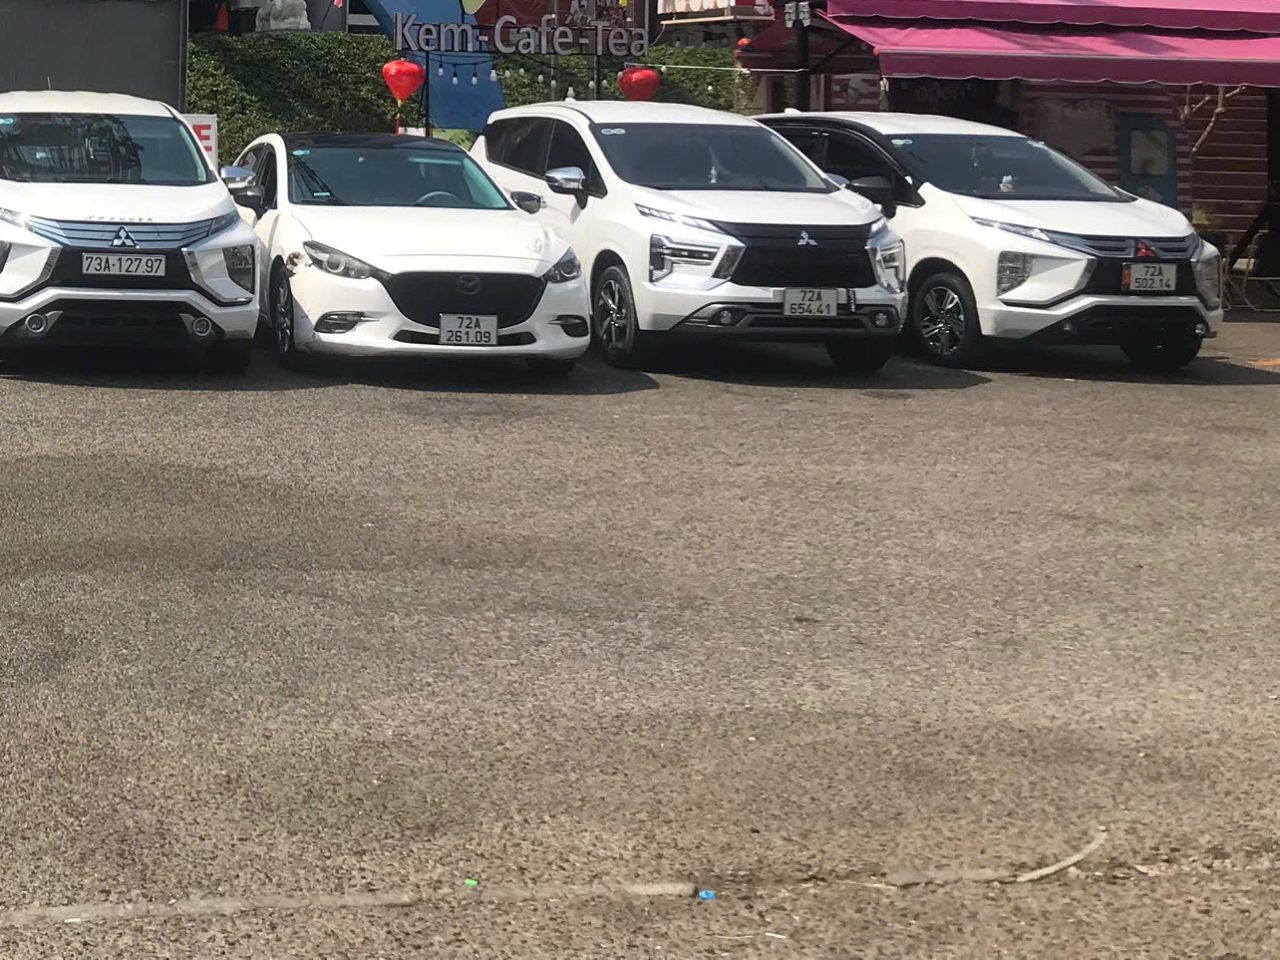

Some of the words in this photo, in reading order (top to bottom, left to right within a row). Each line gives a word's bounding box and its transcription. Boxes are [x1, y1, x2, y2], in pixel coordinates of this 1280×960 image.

[590, 20, 649, 57] Tea
[85, 256, 163, 274] 73A-127.97
[1144, 265, 1164, 277] 72A
[800, 290, 823, 302] 72A
[789, 303, 831, 315] 654.41
[456, 317, 481, 330] 72A
[446, 330, 492, 343] 261.09
